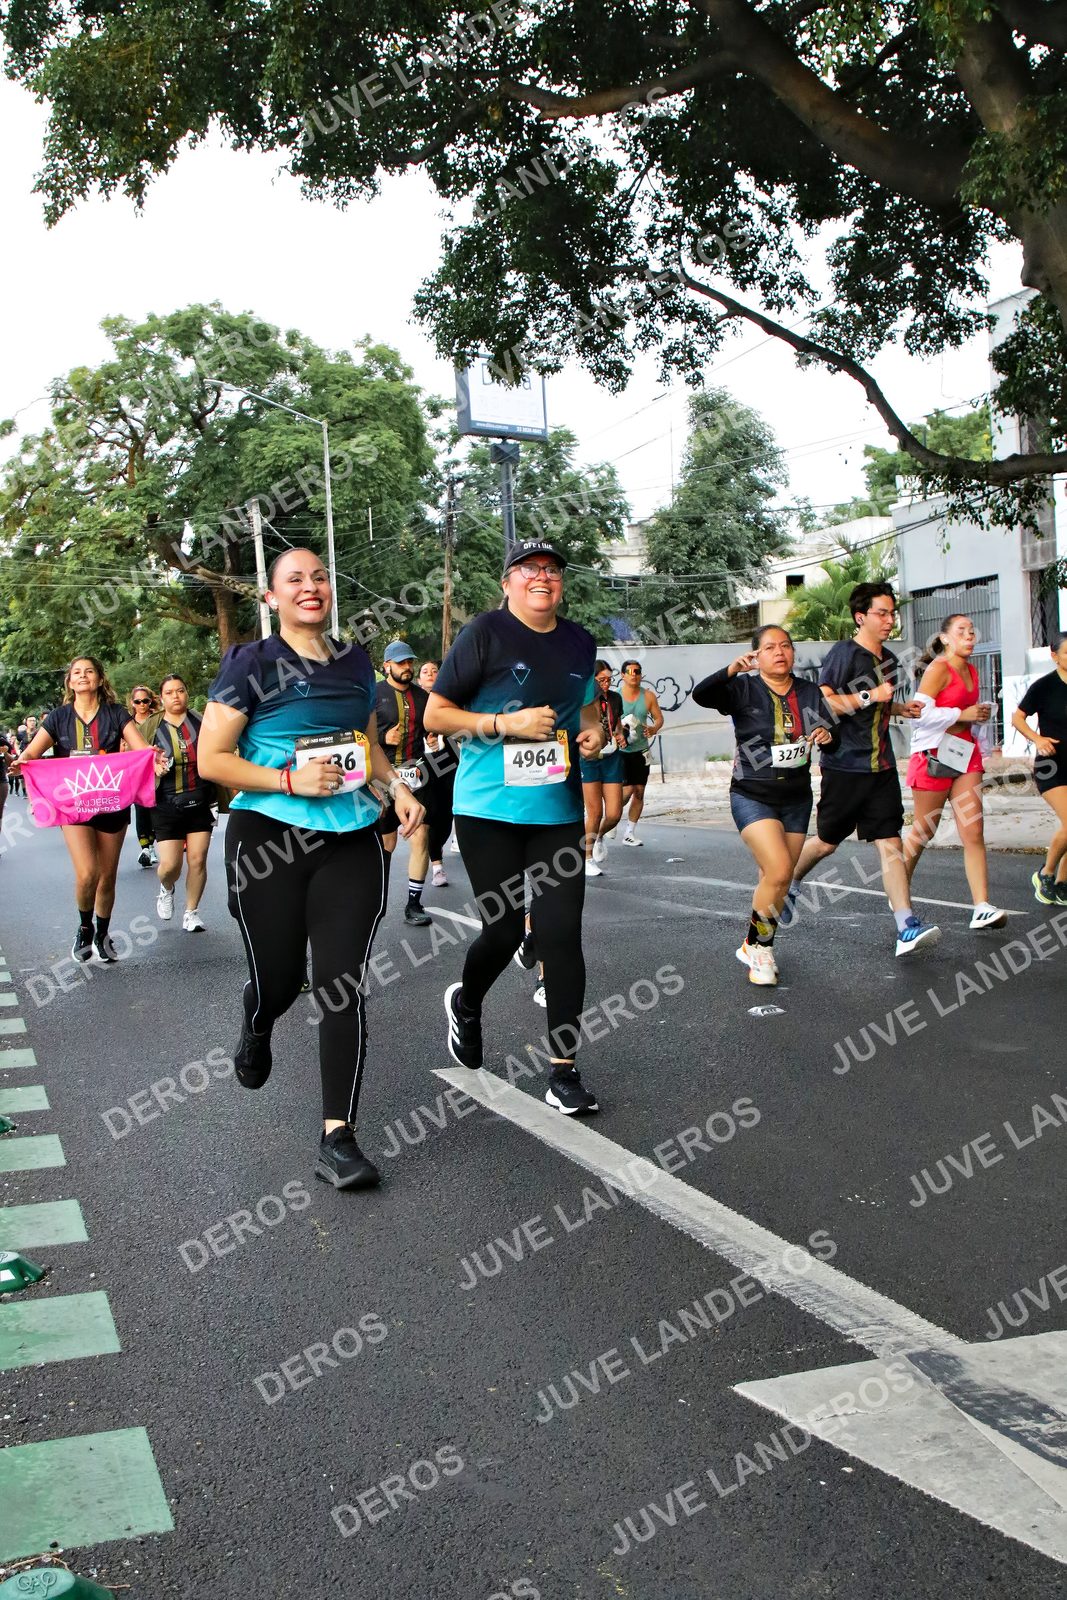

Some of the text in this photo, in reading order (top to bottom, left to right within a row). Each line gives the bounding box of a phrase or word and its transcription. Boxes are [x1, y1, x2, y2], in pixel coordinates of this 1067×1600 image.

[512, 748, 558, 768] 4964
[778, 746, 806, 762] 3279
[74, 795, 120, 807] MUJERES
